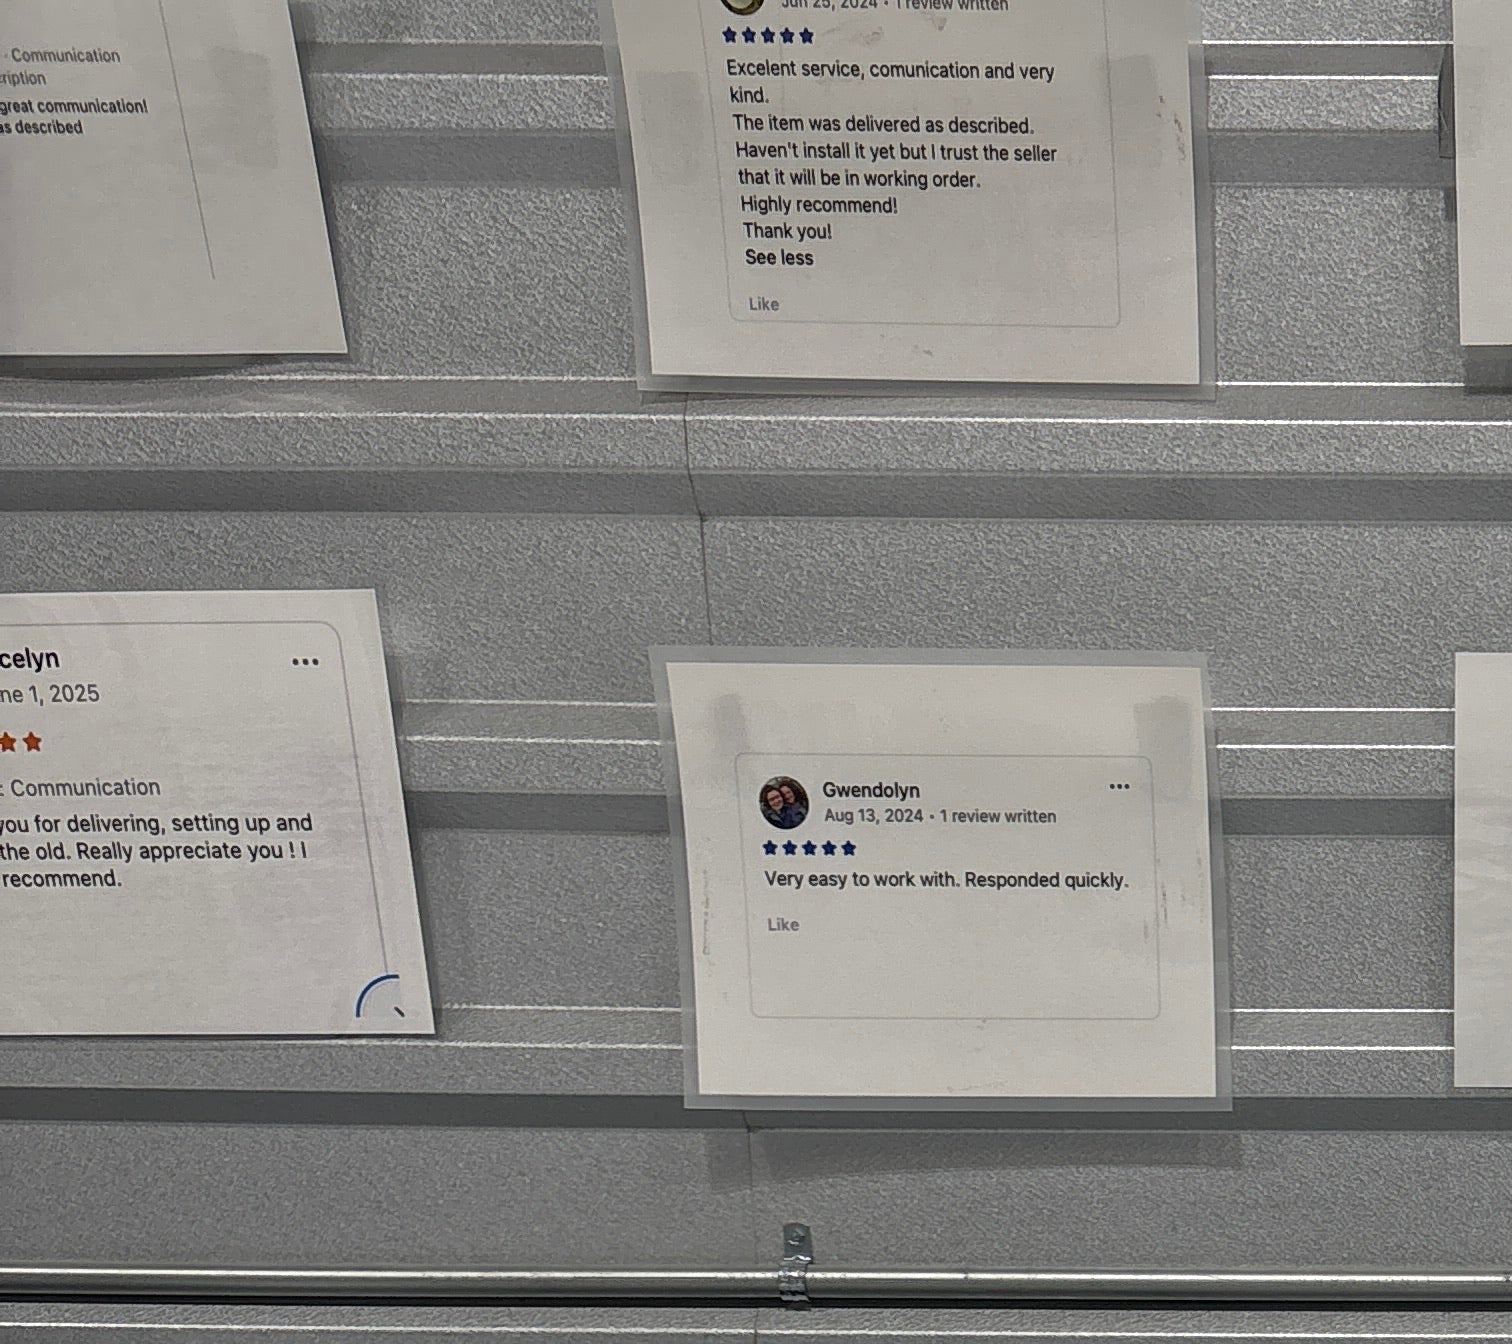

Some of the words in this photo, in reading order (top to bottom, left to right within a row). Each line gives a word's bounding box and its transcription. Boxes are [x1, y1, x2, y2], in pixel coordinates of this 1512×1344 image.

[11, 48, 120, 63] Communication
[727, 59, 797, 76] Excelent
[802, 61, 864, 80] service,
[870, 62, 979, 78] comunication
[985, 63, 1014, 79] and
[1019, 67, 1054, 83] very
[37, 98, 148, 113] communication!
[15, 119, 83, 135] described
[732, 114, 764, 131] The
[768, 114, 804, 131] item
[809, 118, 841, 131] was
[846, 115, 920, 132] delivered
[926, 120, 944, 133] as
[949, 116, 1034, 134] described.
[741, 195, 791, 215] Highly
[797, 197, 897, 214] recommend!
[749, 297, 779, 311] Like
[0, 648, 60, 673] celyn
[29, 685, 43, 706] 1,
[50, 684, 99, 702] 2025
[11, 778, 160, 797] Communication
[823, 782, 920, 801] Gwendolyn
[825, 808, 854, 825] Aug
[858, 808, 879, 825] 13,
[885, 808, 924, 822] 2024
[940, 809, 947, 822] 1
[952, 808, 1000, 823] review
[1005, 809, 1056, 823] written
[2, 869, 122, 887] recommend.
[764, 871, 803, 889] Very
[808, 874, 847, 890] easy
[852, 872, 870, 886] to
[874, 871, 916, 887] work
[920, 871, 960, 887] with.
[965, 872, 1060, 890] Responded
[1065, 872, 1128, 891] quickly.
